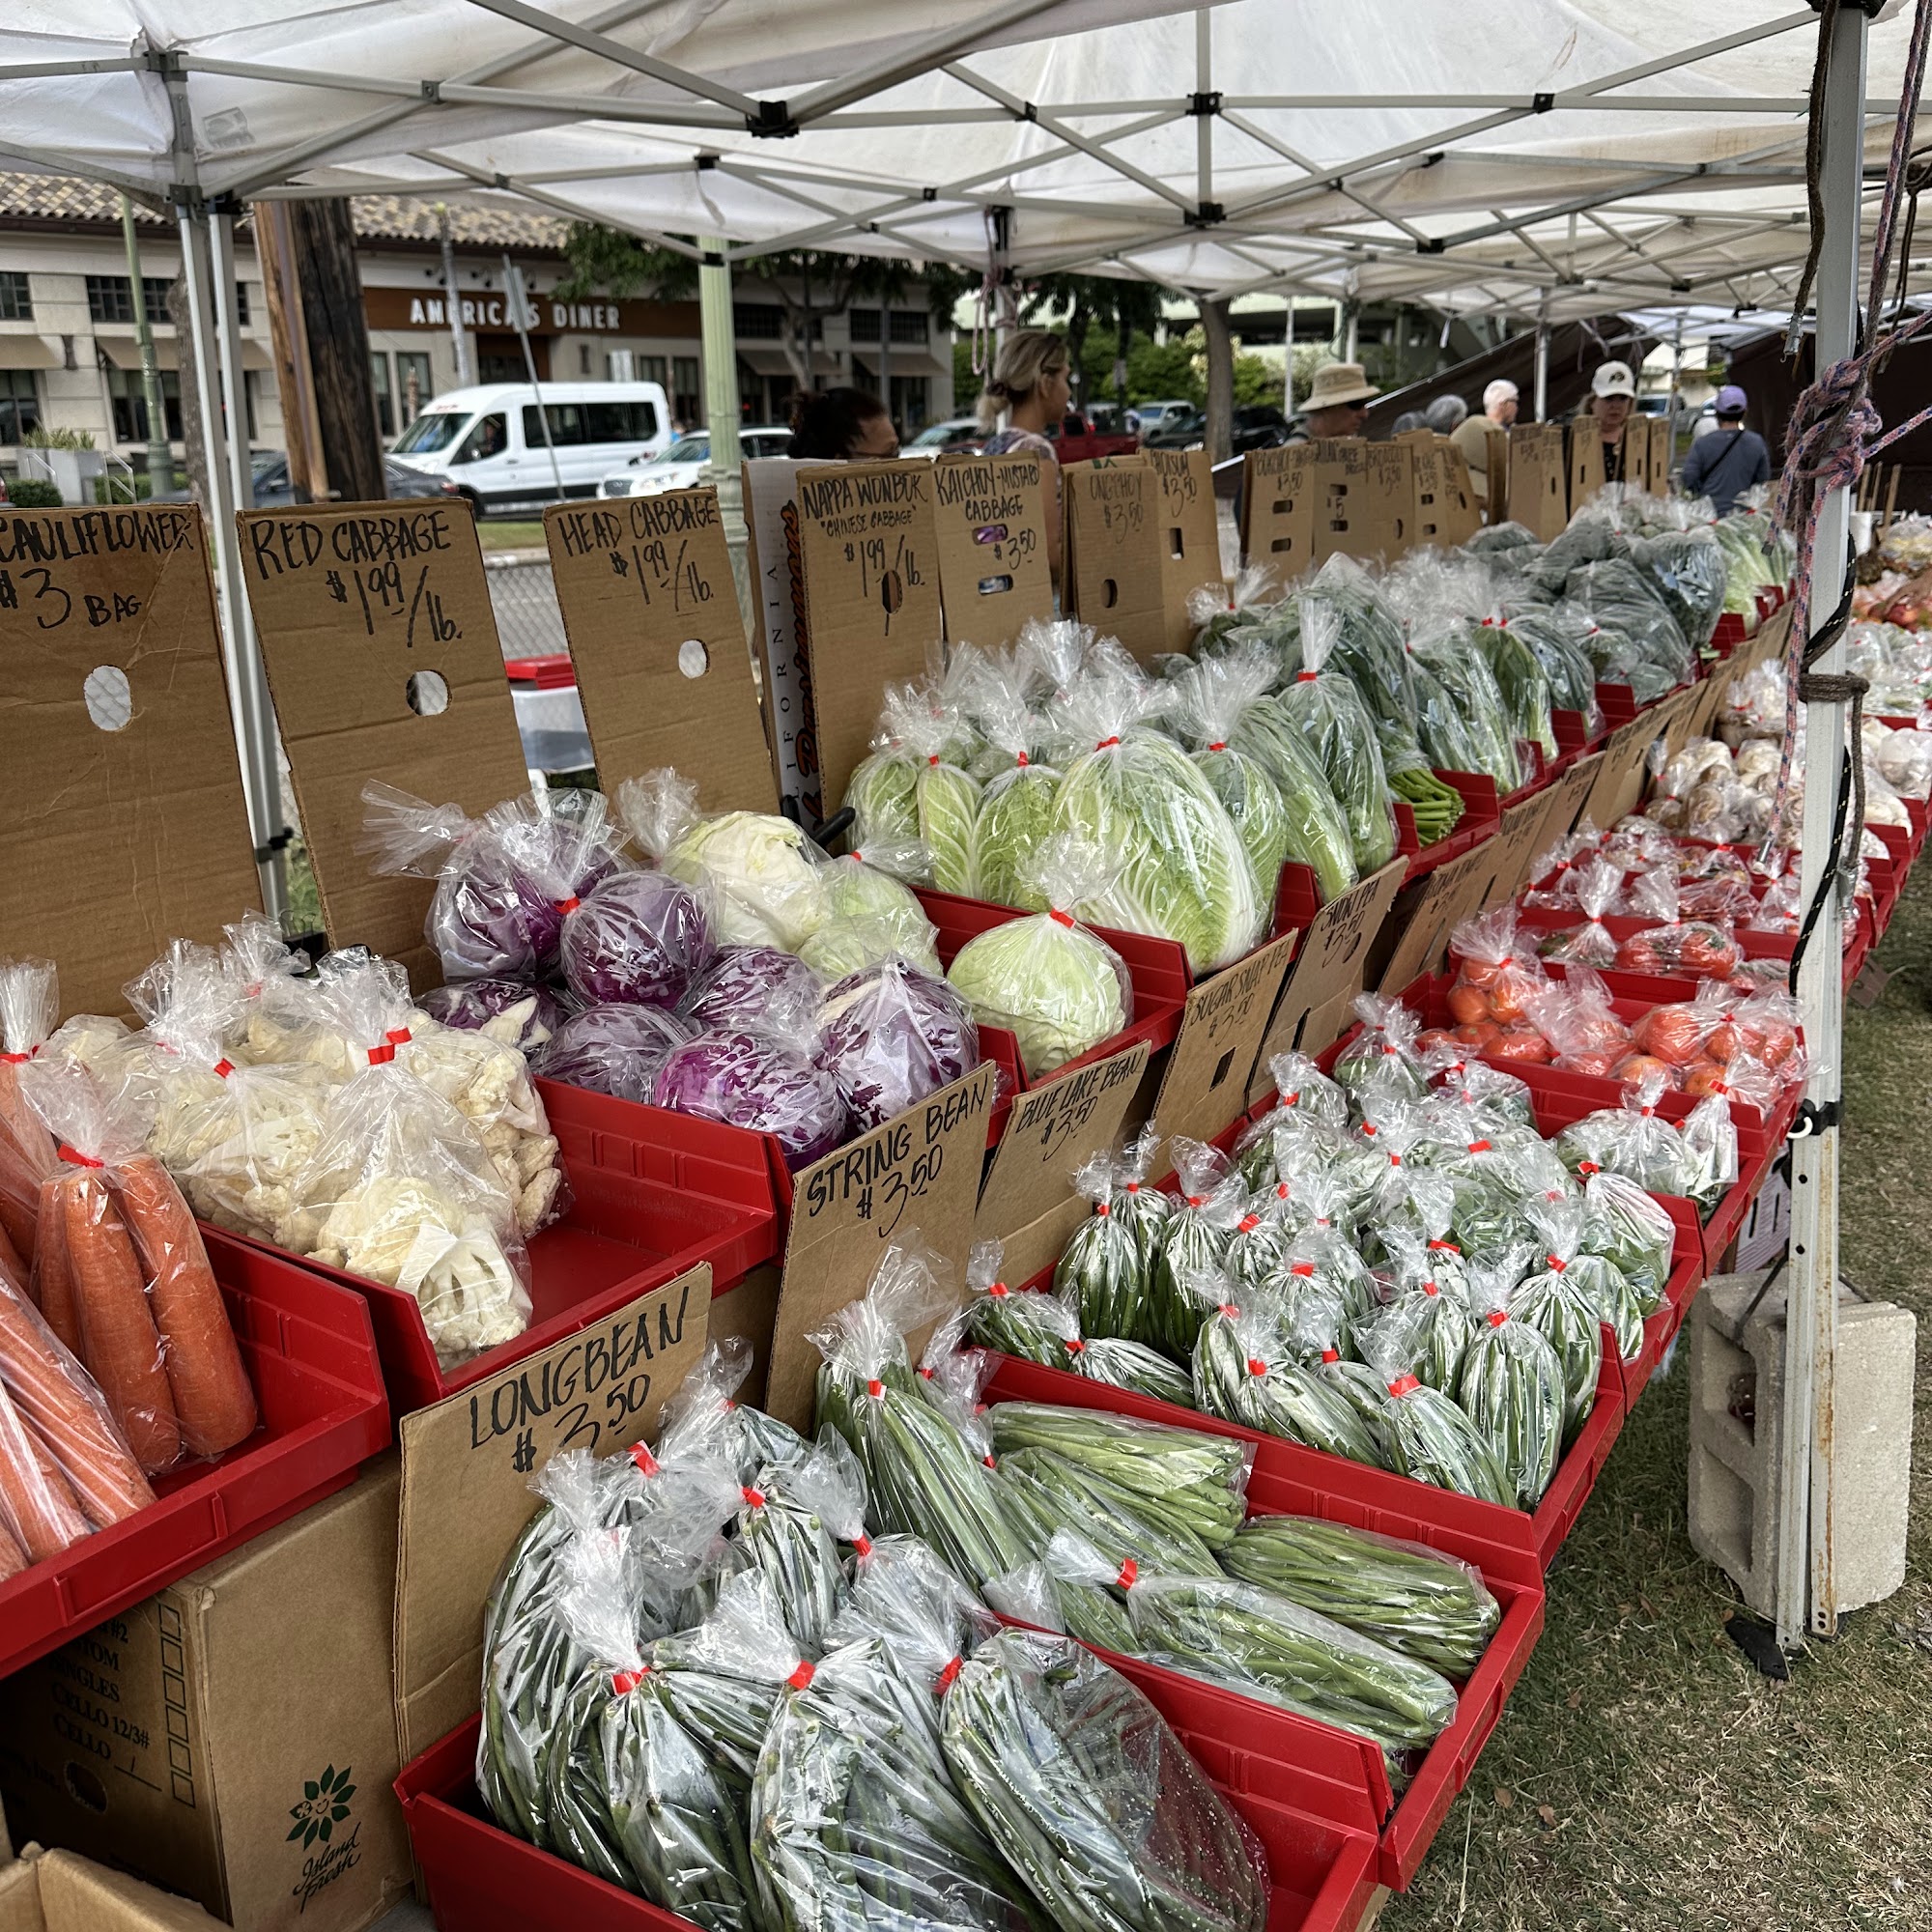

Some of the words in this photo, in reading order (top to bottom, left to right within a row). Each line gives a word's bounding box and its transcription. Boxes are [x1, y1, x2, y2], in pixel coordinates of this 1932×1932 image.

[410, 298, 541, 327] AMRICAS
[553, 302, 620, 329] DINER
[803, 477, 854, 520] NAPPA
[966, 495, 1024, 522] CABBAGE
[0, 511, 193, 562] CAULIFLOWER
[250, 520, 324, 580] RED
[332, 511, 451, 563] CABBAGE
[558, 512, 623, 556] HEAD
[631, 497, 719, 539] CABBAGE
[84, 592, 142, 626] BAG
[1190, 974, 1238, 1026] SUGAR
[1235, 953, 1270, 1000] SNAP
[1267, 939, 1291, 975] PEA
[1015, 1086, 1064, 1134] BLUE
[1059, 1066, 1102, 1111] LAKE
[1099, 1048, 1145, 1092] BEAN
[808, 1123, 912, 1217] STRING
[926, 1073, 987, 1144] BEAN
[52, 1683, 108, 1728] CELLO
[54, 1714, 110, 1759] CELLO
[293, 1821, 362, 1895] Island
[300, 1848, 362, 1915] Fresh
